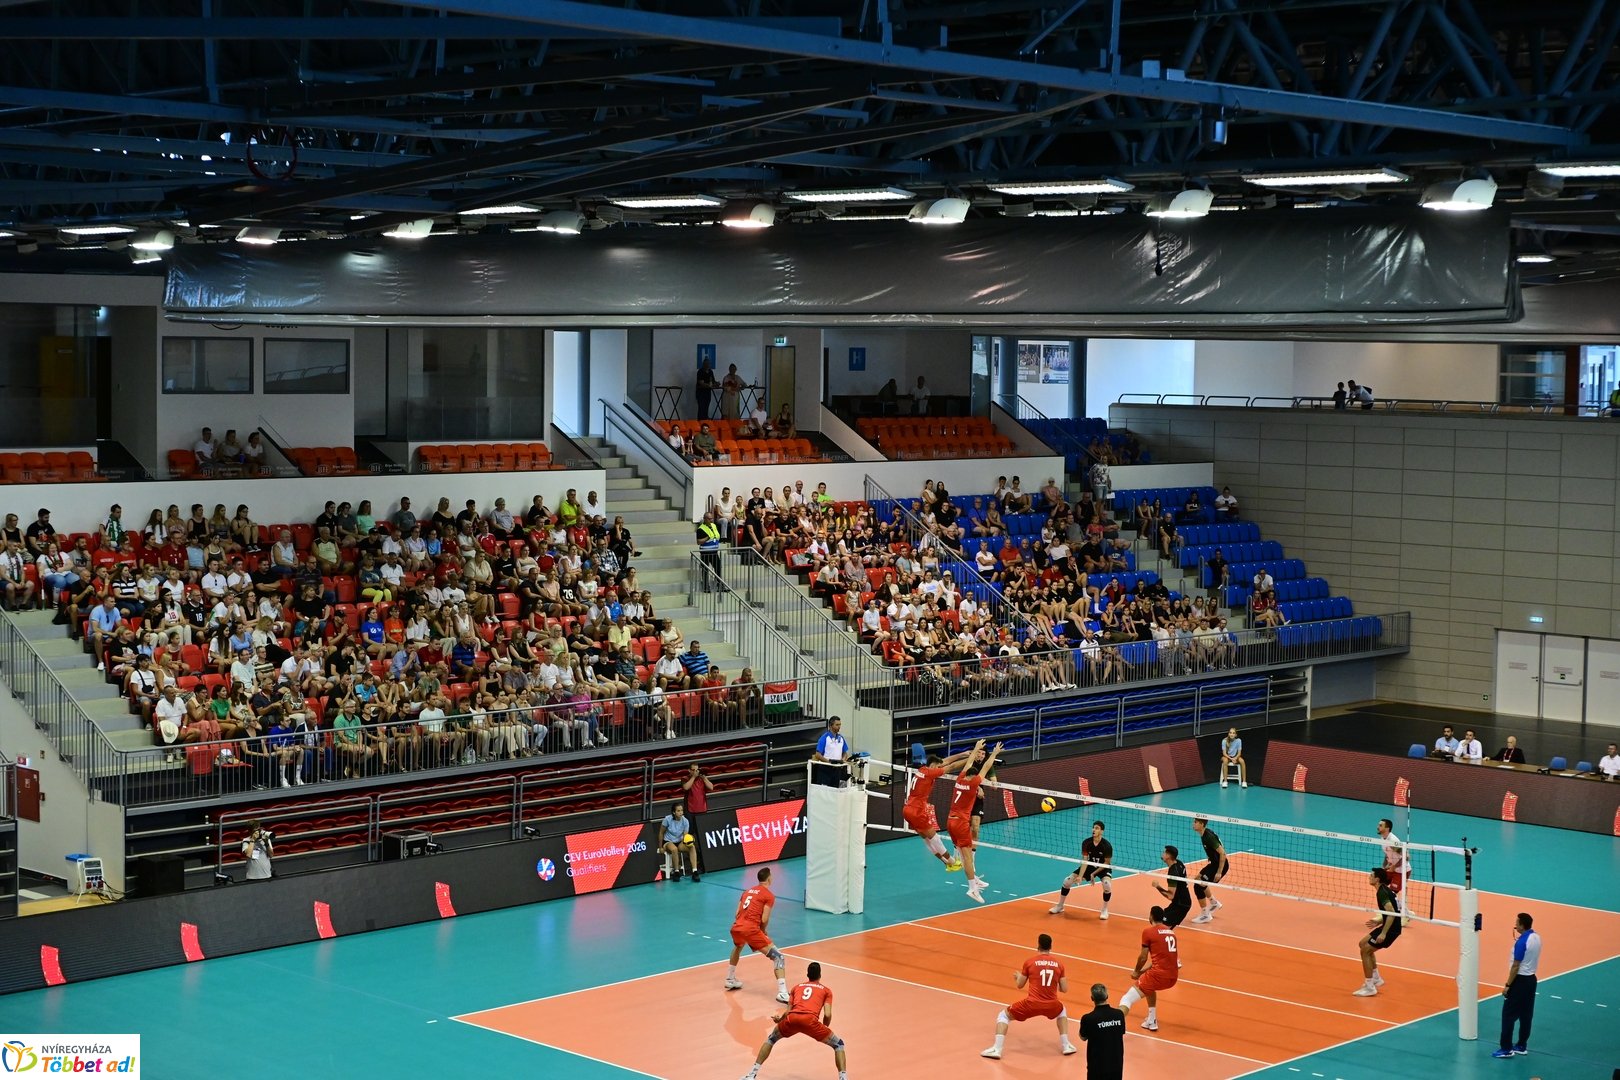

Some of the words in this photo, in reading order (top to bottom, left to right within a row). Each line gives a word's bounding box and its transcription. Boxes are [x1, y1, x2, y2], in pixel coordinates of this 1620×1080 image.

[563, 589, 574, 599] 76
[195, 613, 203, 622] 18
[954, 790, 962, 803] 7
[705, 815, 807, 849] NYÍREGYHÁZA
[564, 852, 581, 863] CEV
[583, 845, 625, 860] EuroVolley
[627, 841, 646, 853] 2026
[566, 863, 607, 877] Qualifiers
[743, 896, 752, 909] 5
[1165, 936, 1176, 952] 12
[1040, 969, 1054, 986] 17
[802, 986, 812, 1000] 9
[1098, 1020, 1121, 1028] TÜRKİYE
